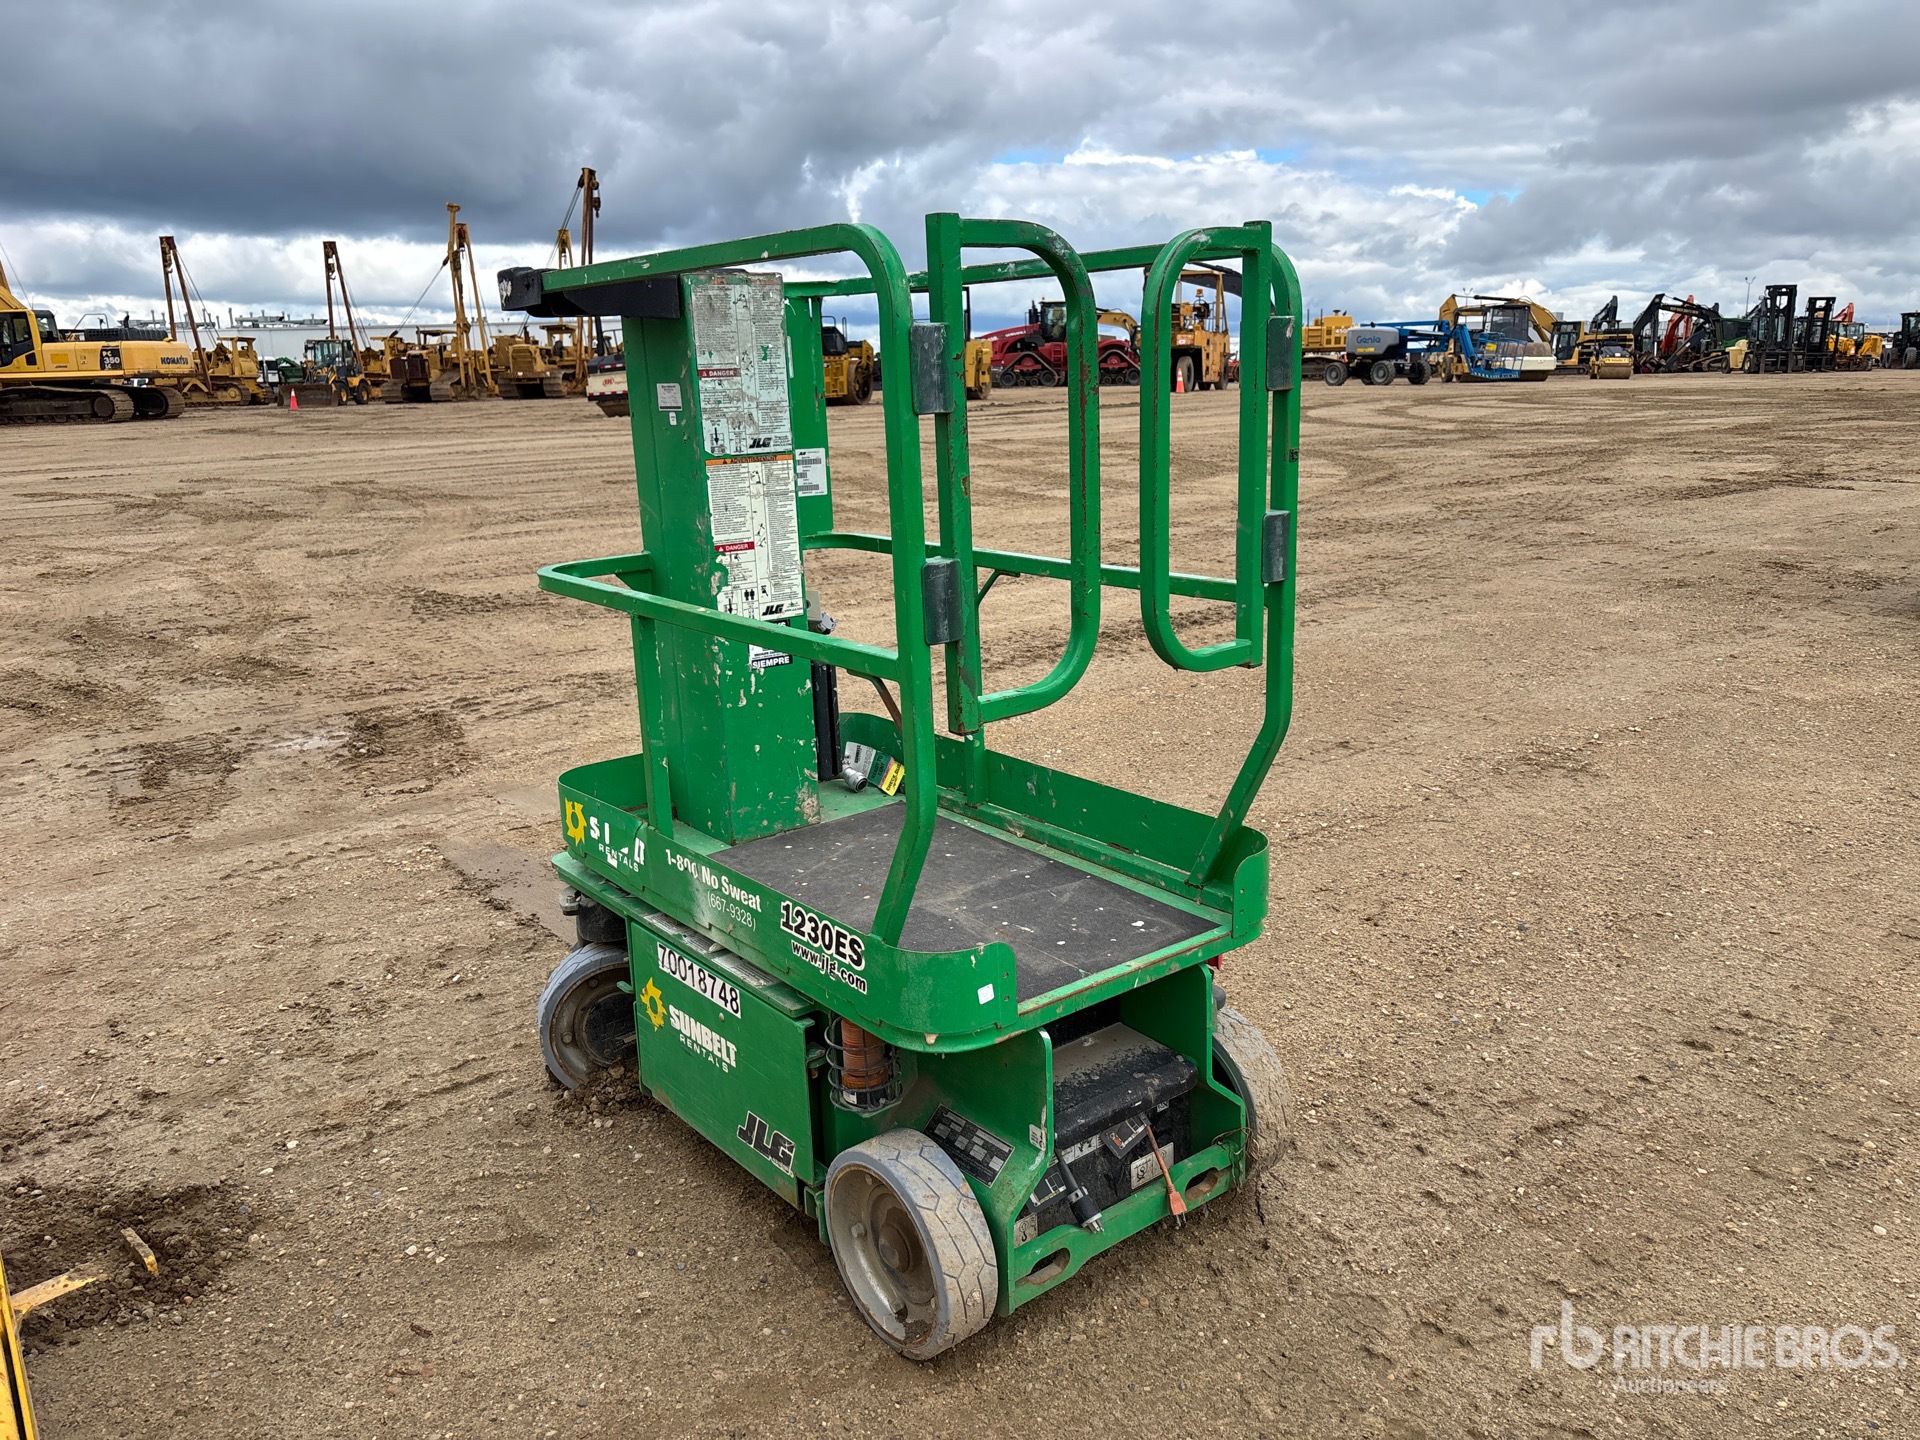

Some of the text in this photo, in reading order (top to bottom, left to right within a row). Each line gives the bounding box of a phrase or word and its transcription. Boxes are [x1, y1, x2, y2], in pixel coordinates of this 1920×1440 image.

[1356, 335, 1381, 344] Genie
[160, 355, 188, 365] KOMATSU
[709, 369, 734, 377] DANGER
[749, 437, 772, 449] JLG
[725, 543, 749, 551] DANGER
[762, 603, 784, 616] JLG
[752, 656, 790, 669] SIEMPRE
[886, 774, 899, 791] CHECK
[599, 843, 639, 872] RENTALS
[701, 865, 719, 889] No
[721, 875, 761, 912] Sweat
[707, 890, 756, 932] (667-9328)
[781, 902, 864, 969] 1230ES
[658, 943, 740, 1015] 70018748
[791, 941, 867, 994] www.jlg.com
[669, 1004, 737, 1068] SUNBELT
[680, 1033, 729, 1073] RENTALS
[737, 1110, 796, 1176] JLG
